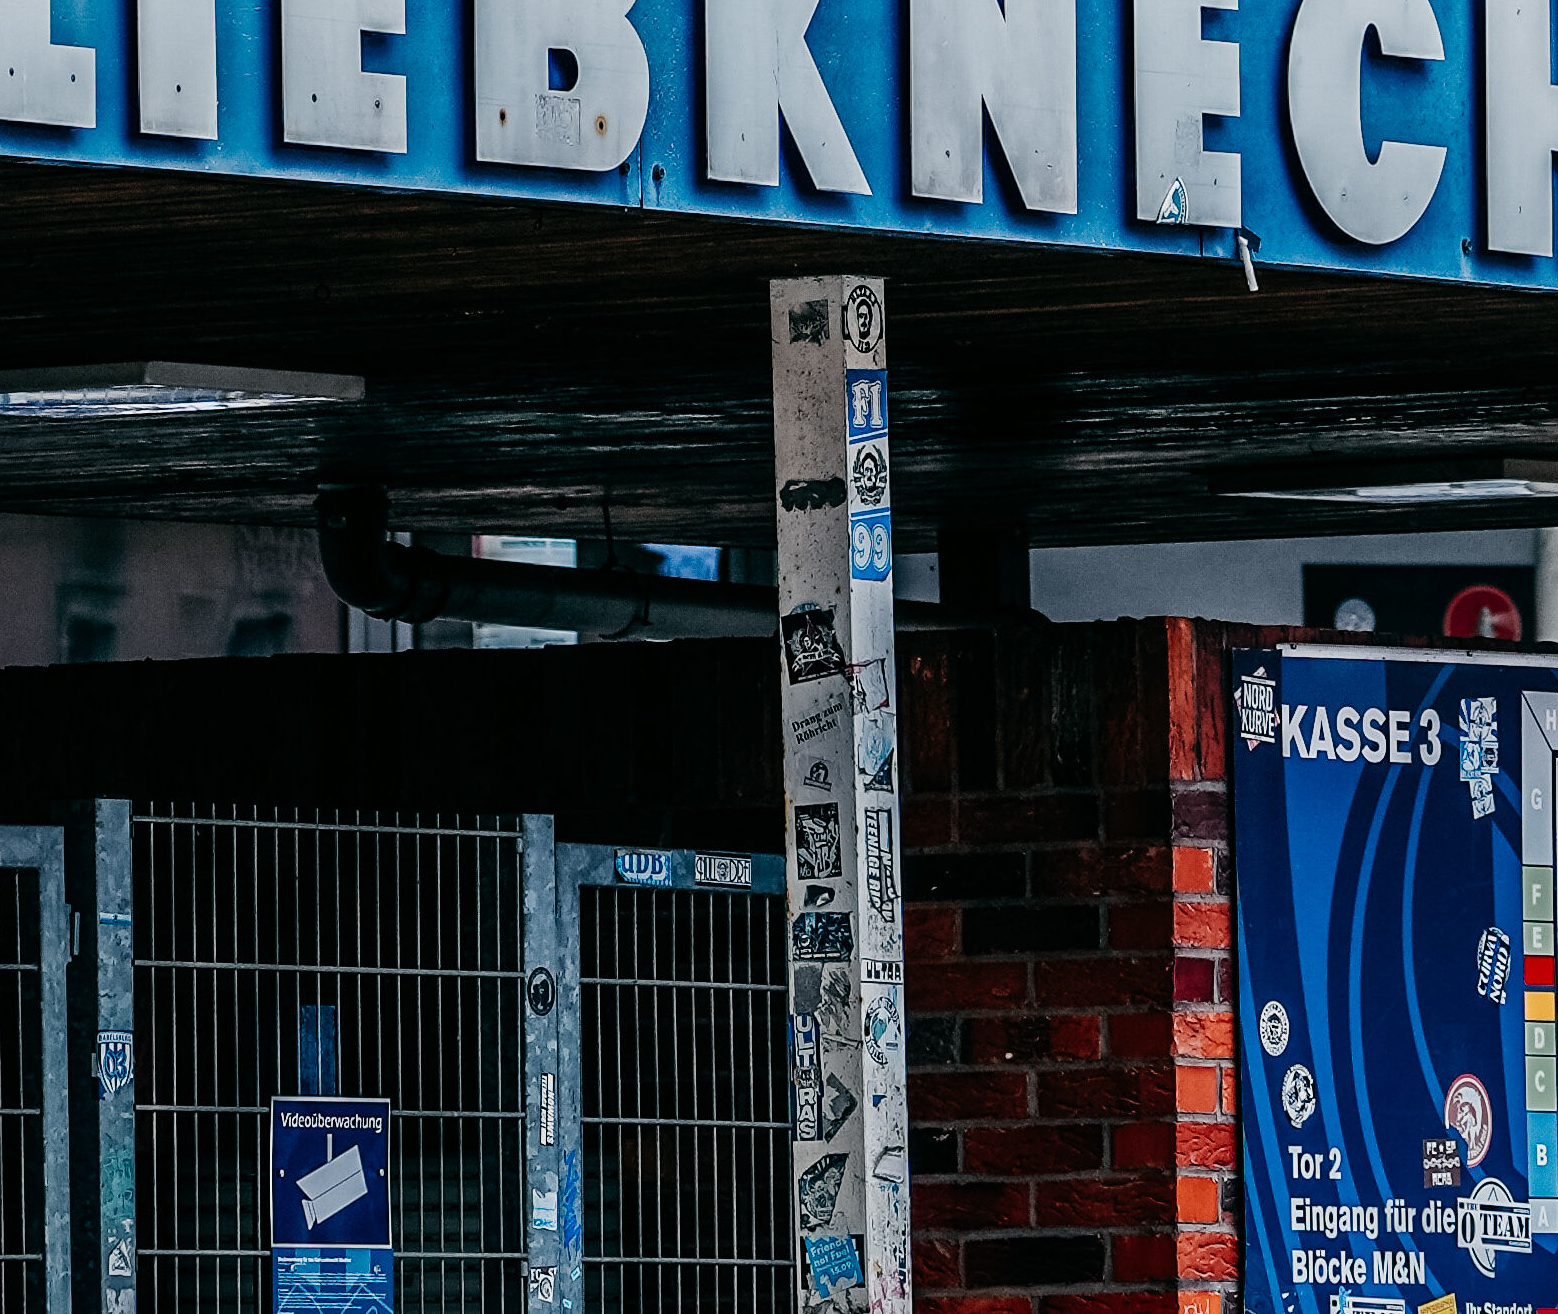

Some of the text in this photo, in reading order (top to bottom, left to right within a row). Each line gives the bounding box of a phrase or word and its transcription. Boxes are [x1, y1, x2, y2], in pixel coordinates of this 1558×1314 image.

[851, 522, 890, 573] 99
[1243, 683, 1275, 711] NORD
[791, 702, 843, 733] Drang zum
[1241, 708, 1276, 737] KURVE
[1546, 709, 1557, 731] H
[795, 718, 838, 745] Röhricht
[1281, 703, 1412, 764] KASSE
[1419, 708, 1442, 766] 3
[1530, 788, 1543, 810] G
[1531, 883, 1542, 905] F
[1532, 926, 1543, 948] E
[866, 961, 902, 981] ULTRA
[1534, 1027, 1545, 1049] D
[104, 1048, 128, 1081] 03
[1534, 1070, 1546, 1093] C
[280, 1112, 383, 1134] Videoüberwachung
[1288, 1145, 1342, 1180] Tor 2
[1536, 1143, 1548, 1166] B
[1290, 1197, 1456, 1240] Eingang für die
[1479, 1212, 1531, 1239] TEAM
[1537, 1205, 1550, 1228] A
[1291, 1249, 1426, 1285] Blöcke M&N
[1483, 1302, 1533, 1314] Standort
